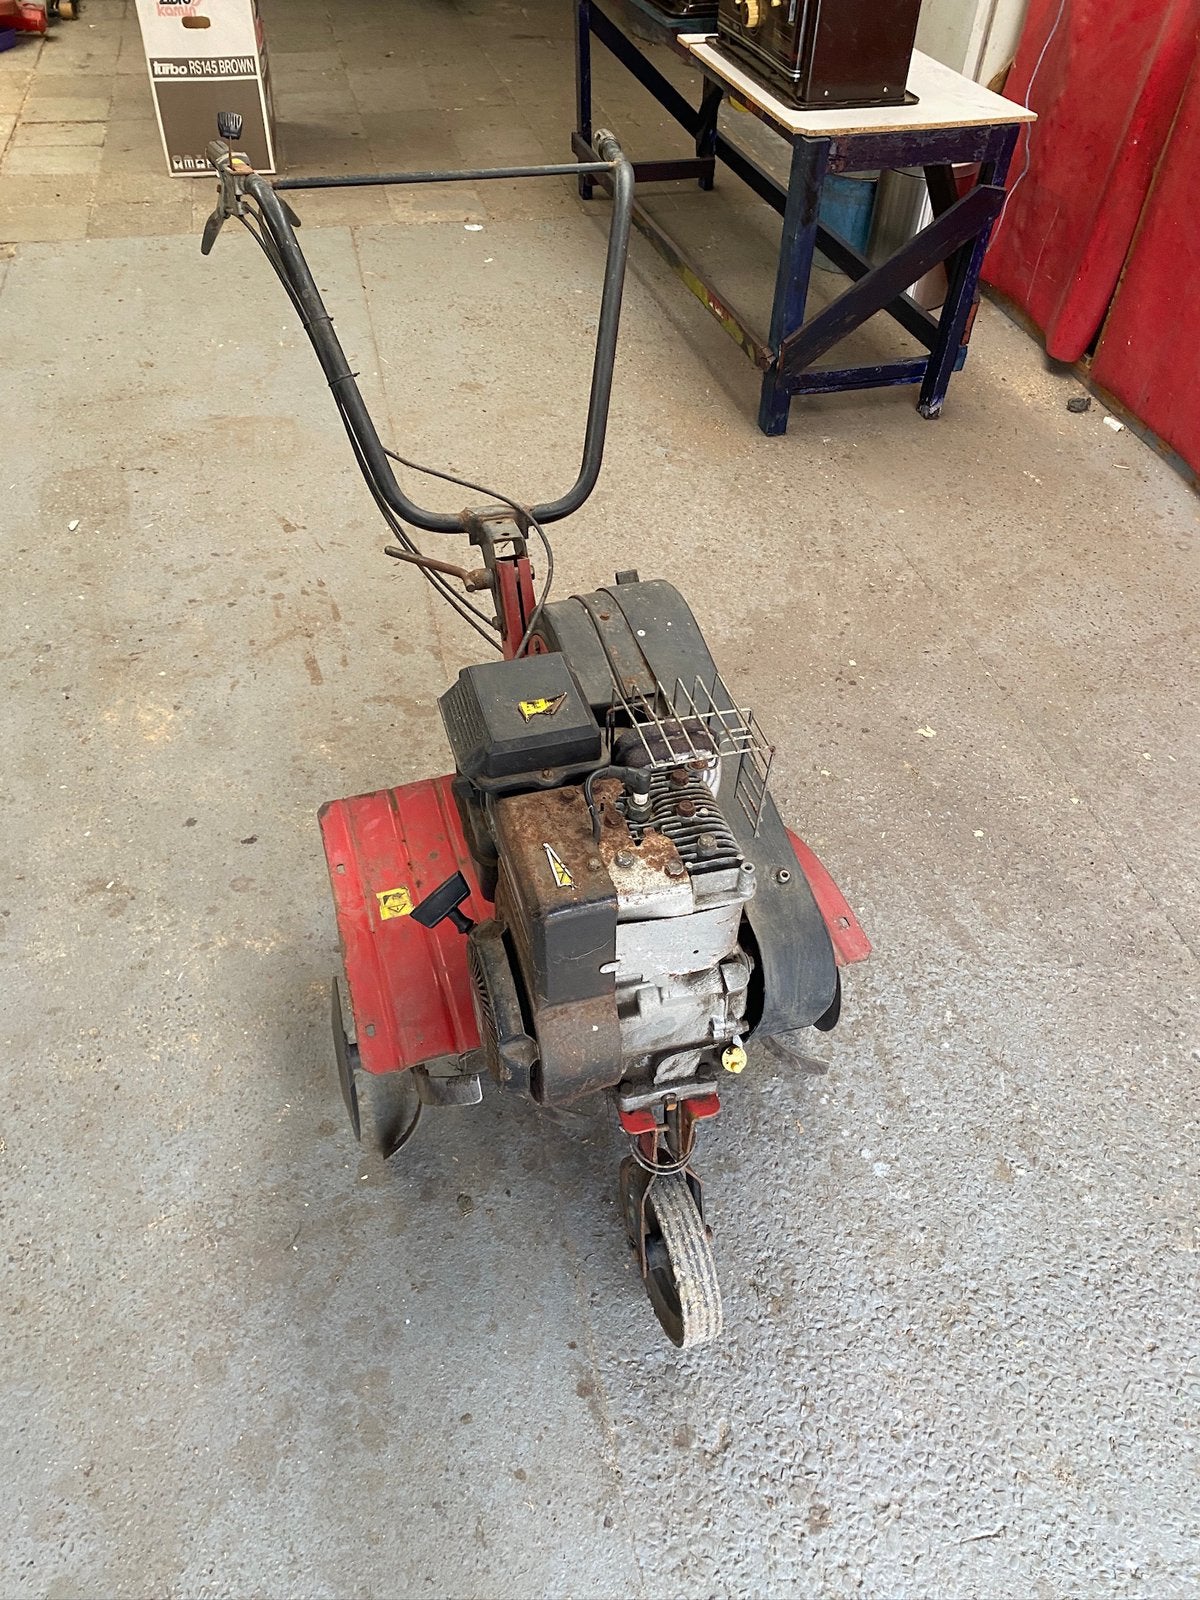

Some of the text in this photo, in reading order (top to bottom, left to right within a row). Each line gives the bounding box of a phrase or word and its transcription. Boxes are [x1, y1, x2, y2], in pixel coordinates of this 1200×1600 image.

[153, 59, 255, 75] turbo RS145 BROWN
